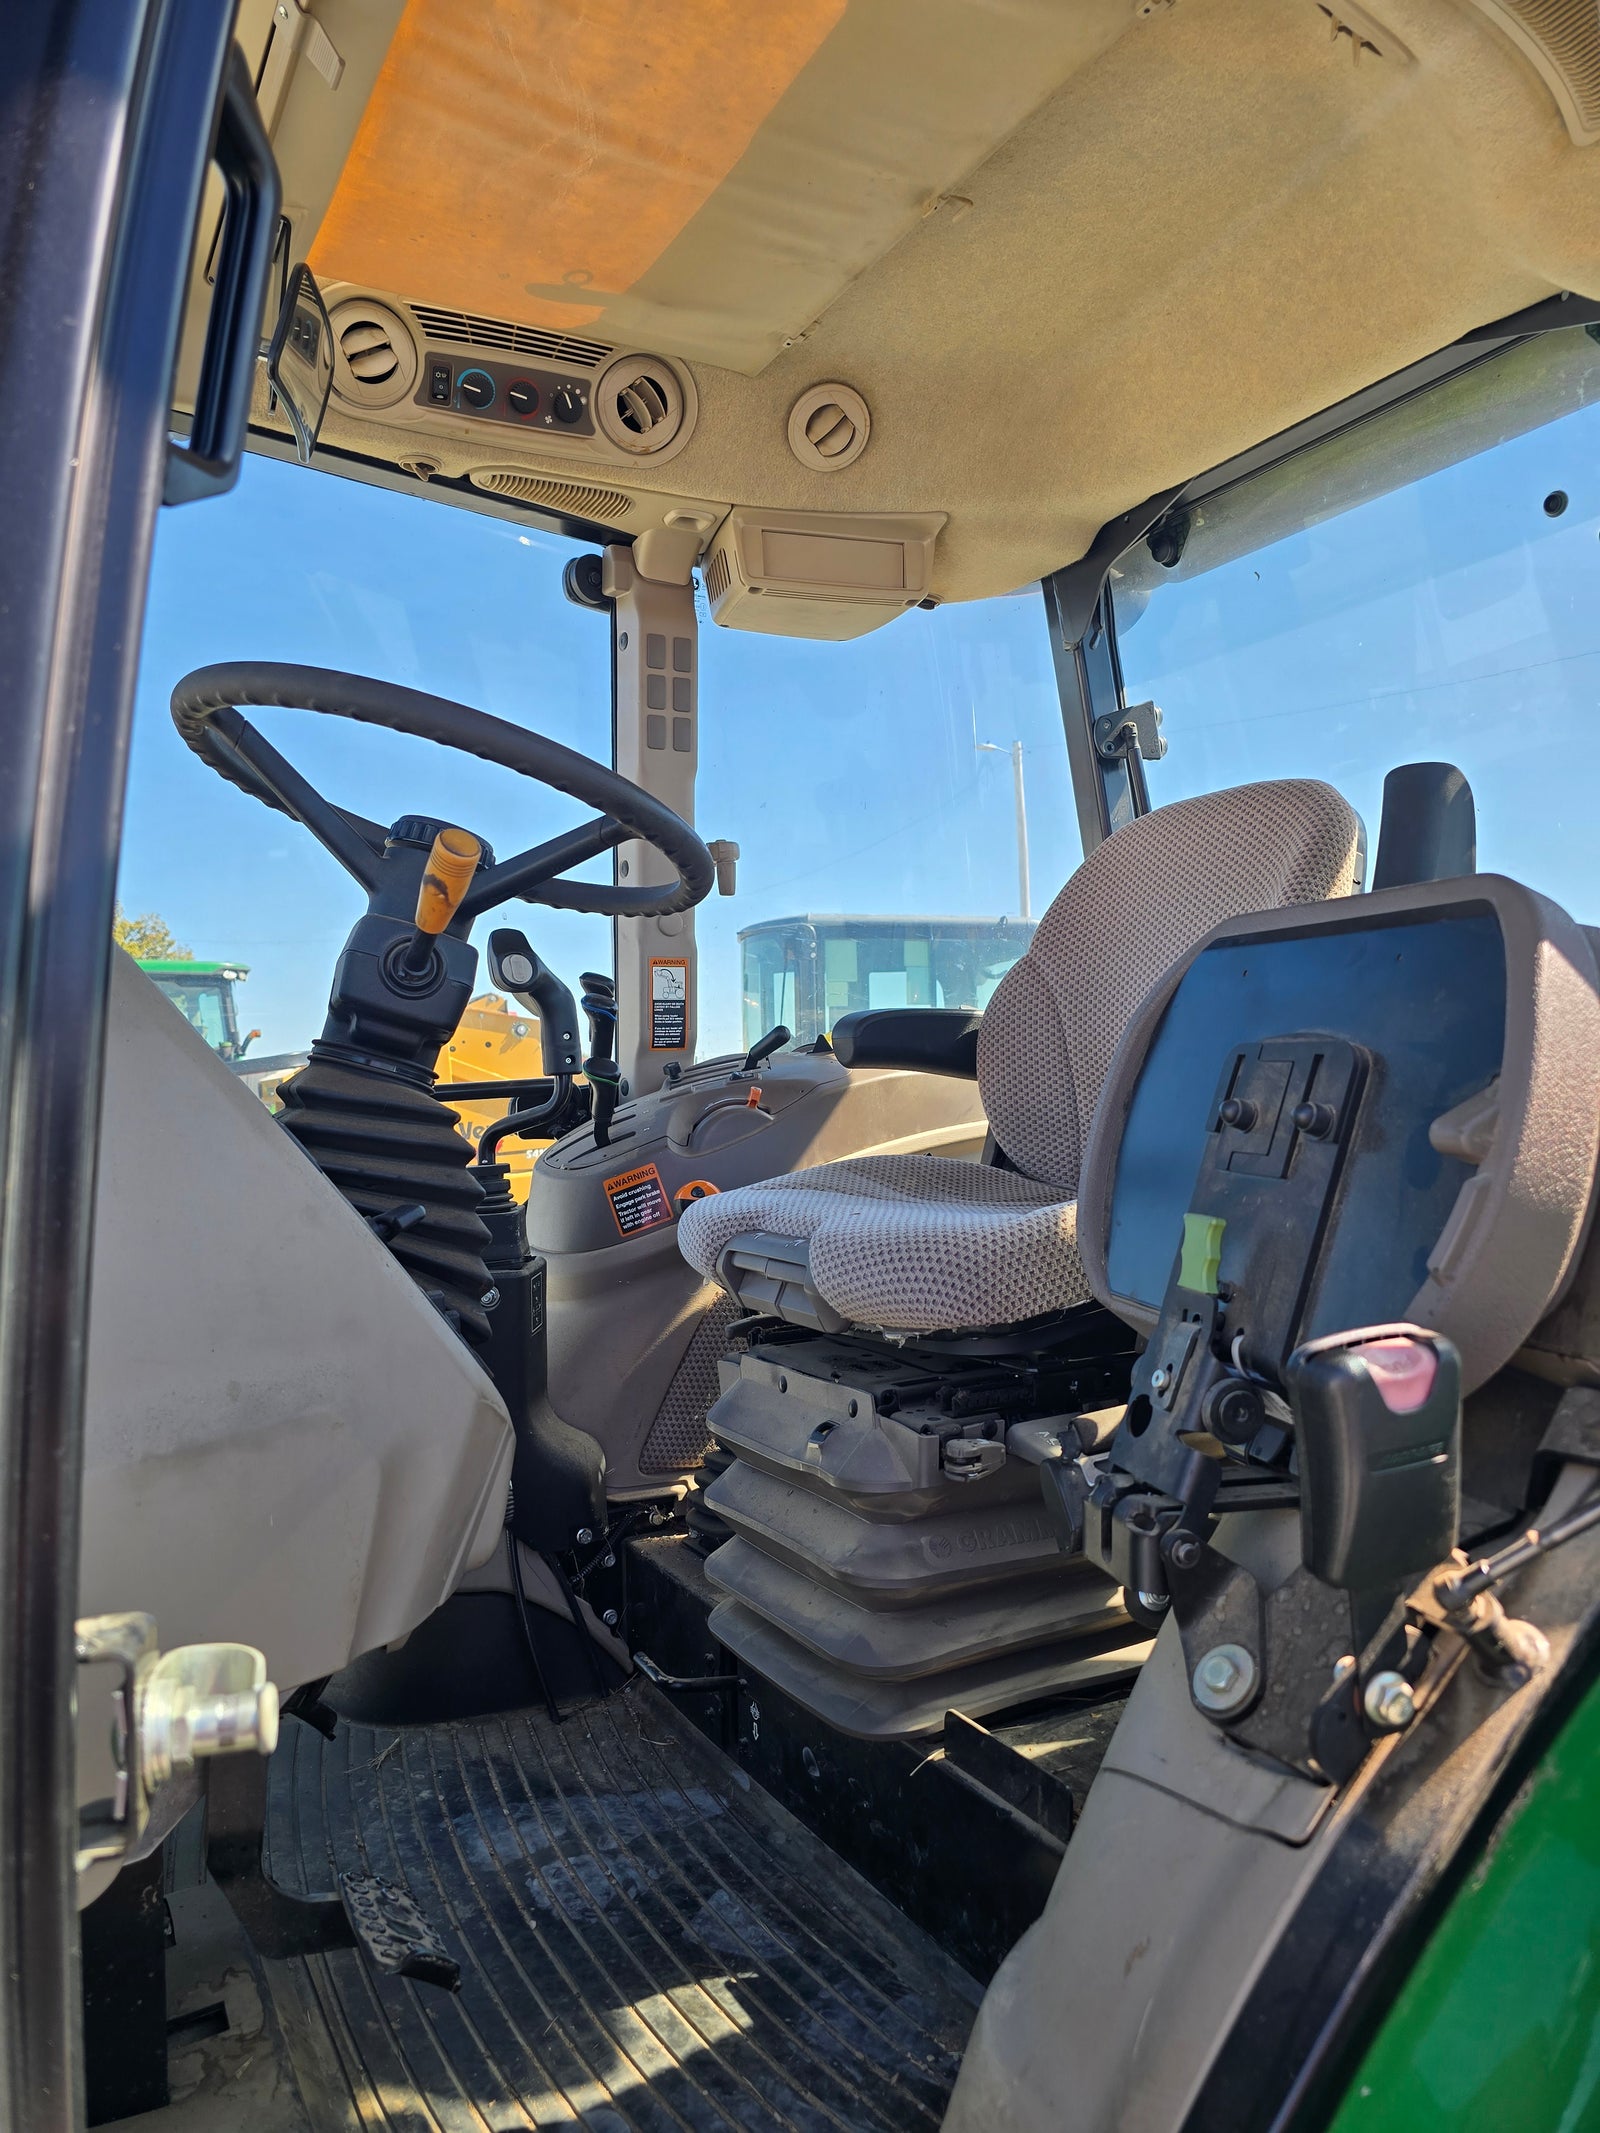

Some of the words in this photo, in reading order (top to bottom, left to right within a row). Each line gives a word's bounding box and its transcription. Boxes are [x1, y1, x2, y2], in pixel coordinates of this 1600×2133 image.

[613, 1167, 656, 1188] WARNING
[613, 1192, 628, 1201] Avoid
[628, 1184, 651, 1196] crushing
[615, 1200, 634, 1209] Engage
[635, 1194, 646, 1203] park
[646, 1189, 660, 1198] brake
[618, 1207, 637, 1217] Tractor
[637, 1202, 646, 1210] will
[647, 1198, 661, 1207] move
[625, 1214, 634, 1222] left
[640, 1208, 652, 1217] gear
[622, 1221, 634, 1230] with
[634, 1215, 652, 1225] engine
[653, 1211, 661, 1219] off
